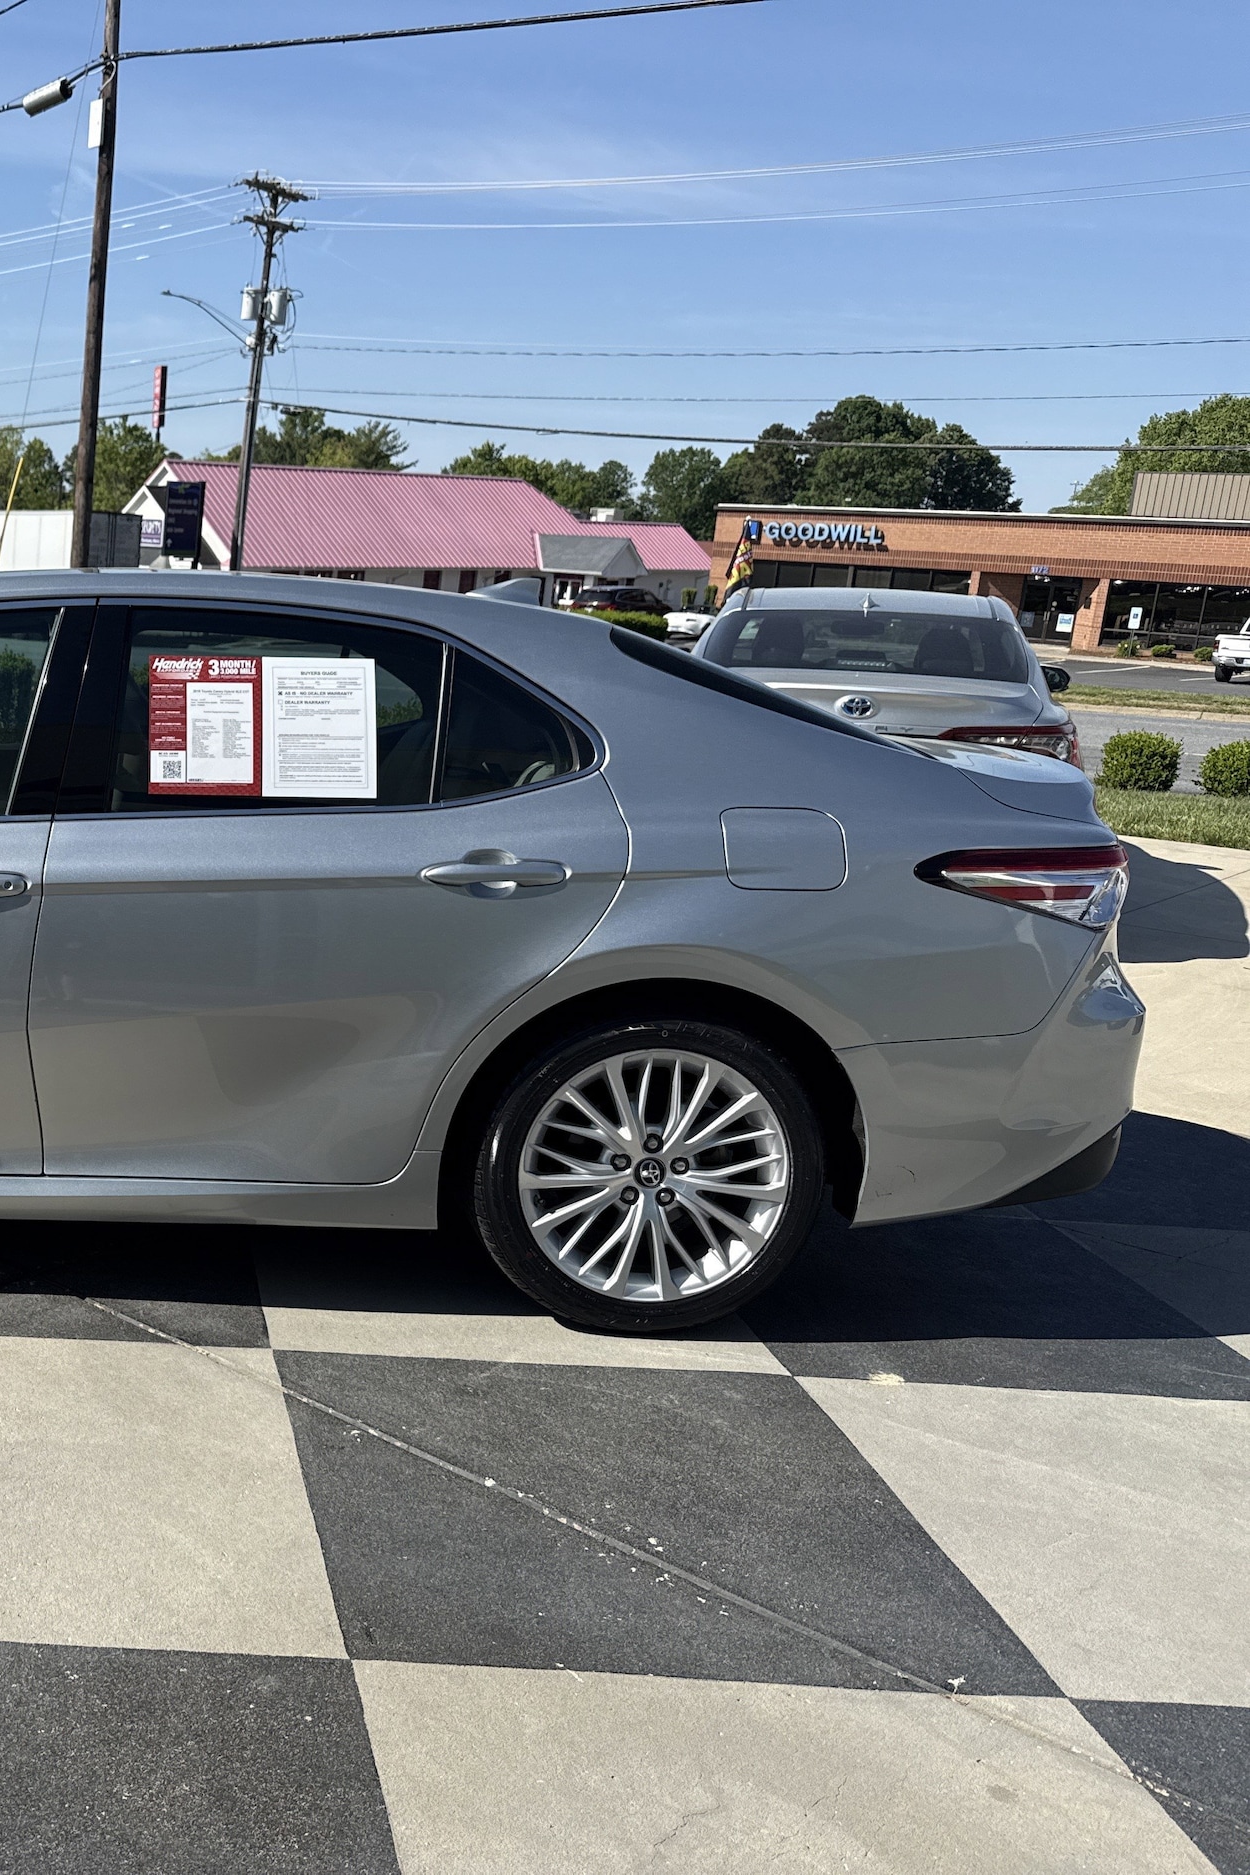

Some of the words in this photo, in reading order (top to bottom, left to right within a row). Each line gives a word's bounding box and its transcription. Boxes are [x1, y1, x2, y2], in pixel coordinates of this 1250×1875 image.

[764, 521, 882, 544] GOODWILL
[152, 657, 204, 673] Hendrick
[208, 659, 220, 676] 3
[240, 667, 257, 675] MILE
